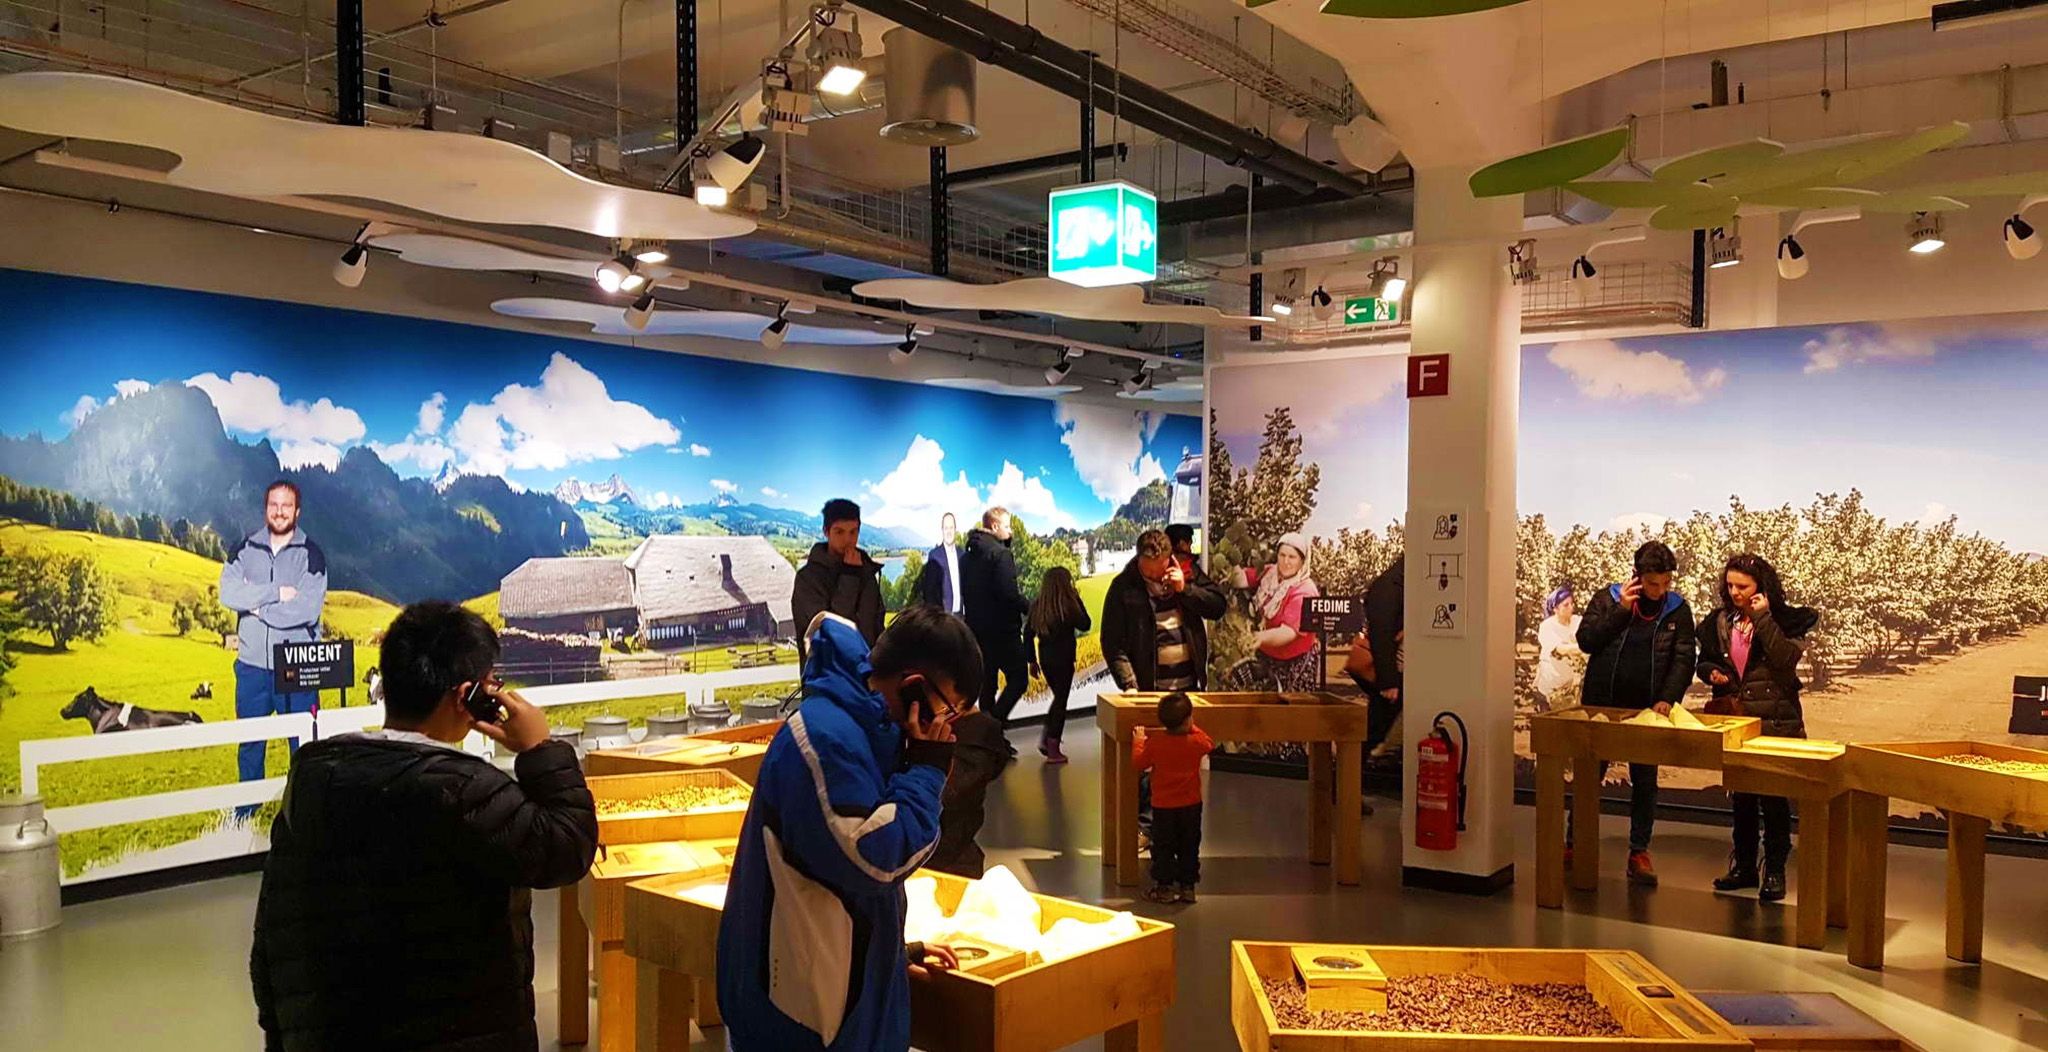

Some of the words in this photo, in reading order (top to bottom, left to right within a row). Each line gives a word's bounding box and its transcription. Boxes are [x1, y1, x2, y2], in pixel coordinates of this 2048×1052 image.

[1419, 360, 1440, 391] F
[1311, 599, 1350, 613] FEDIME
[284, 644, 342, 664] VINCENT
[2039, 685, 2048, 701] J
